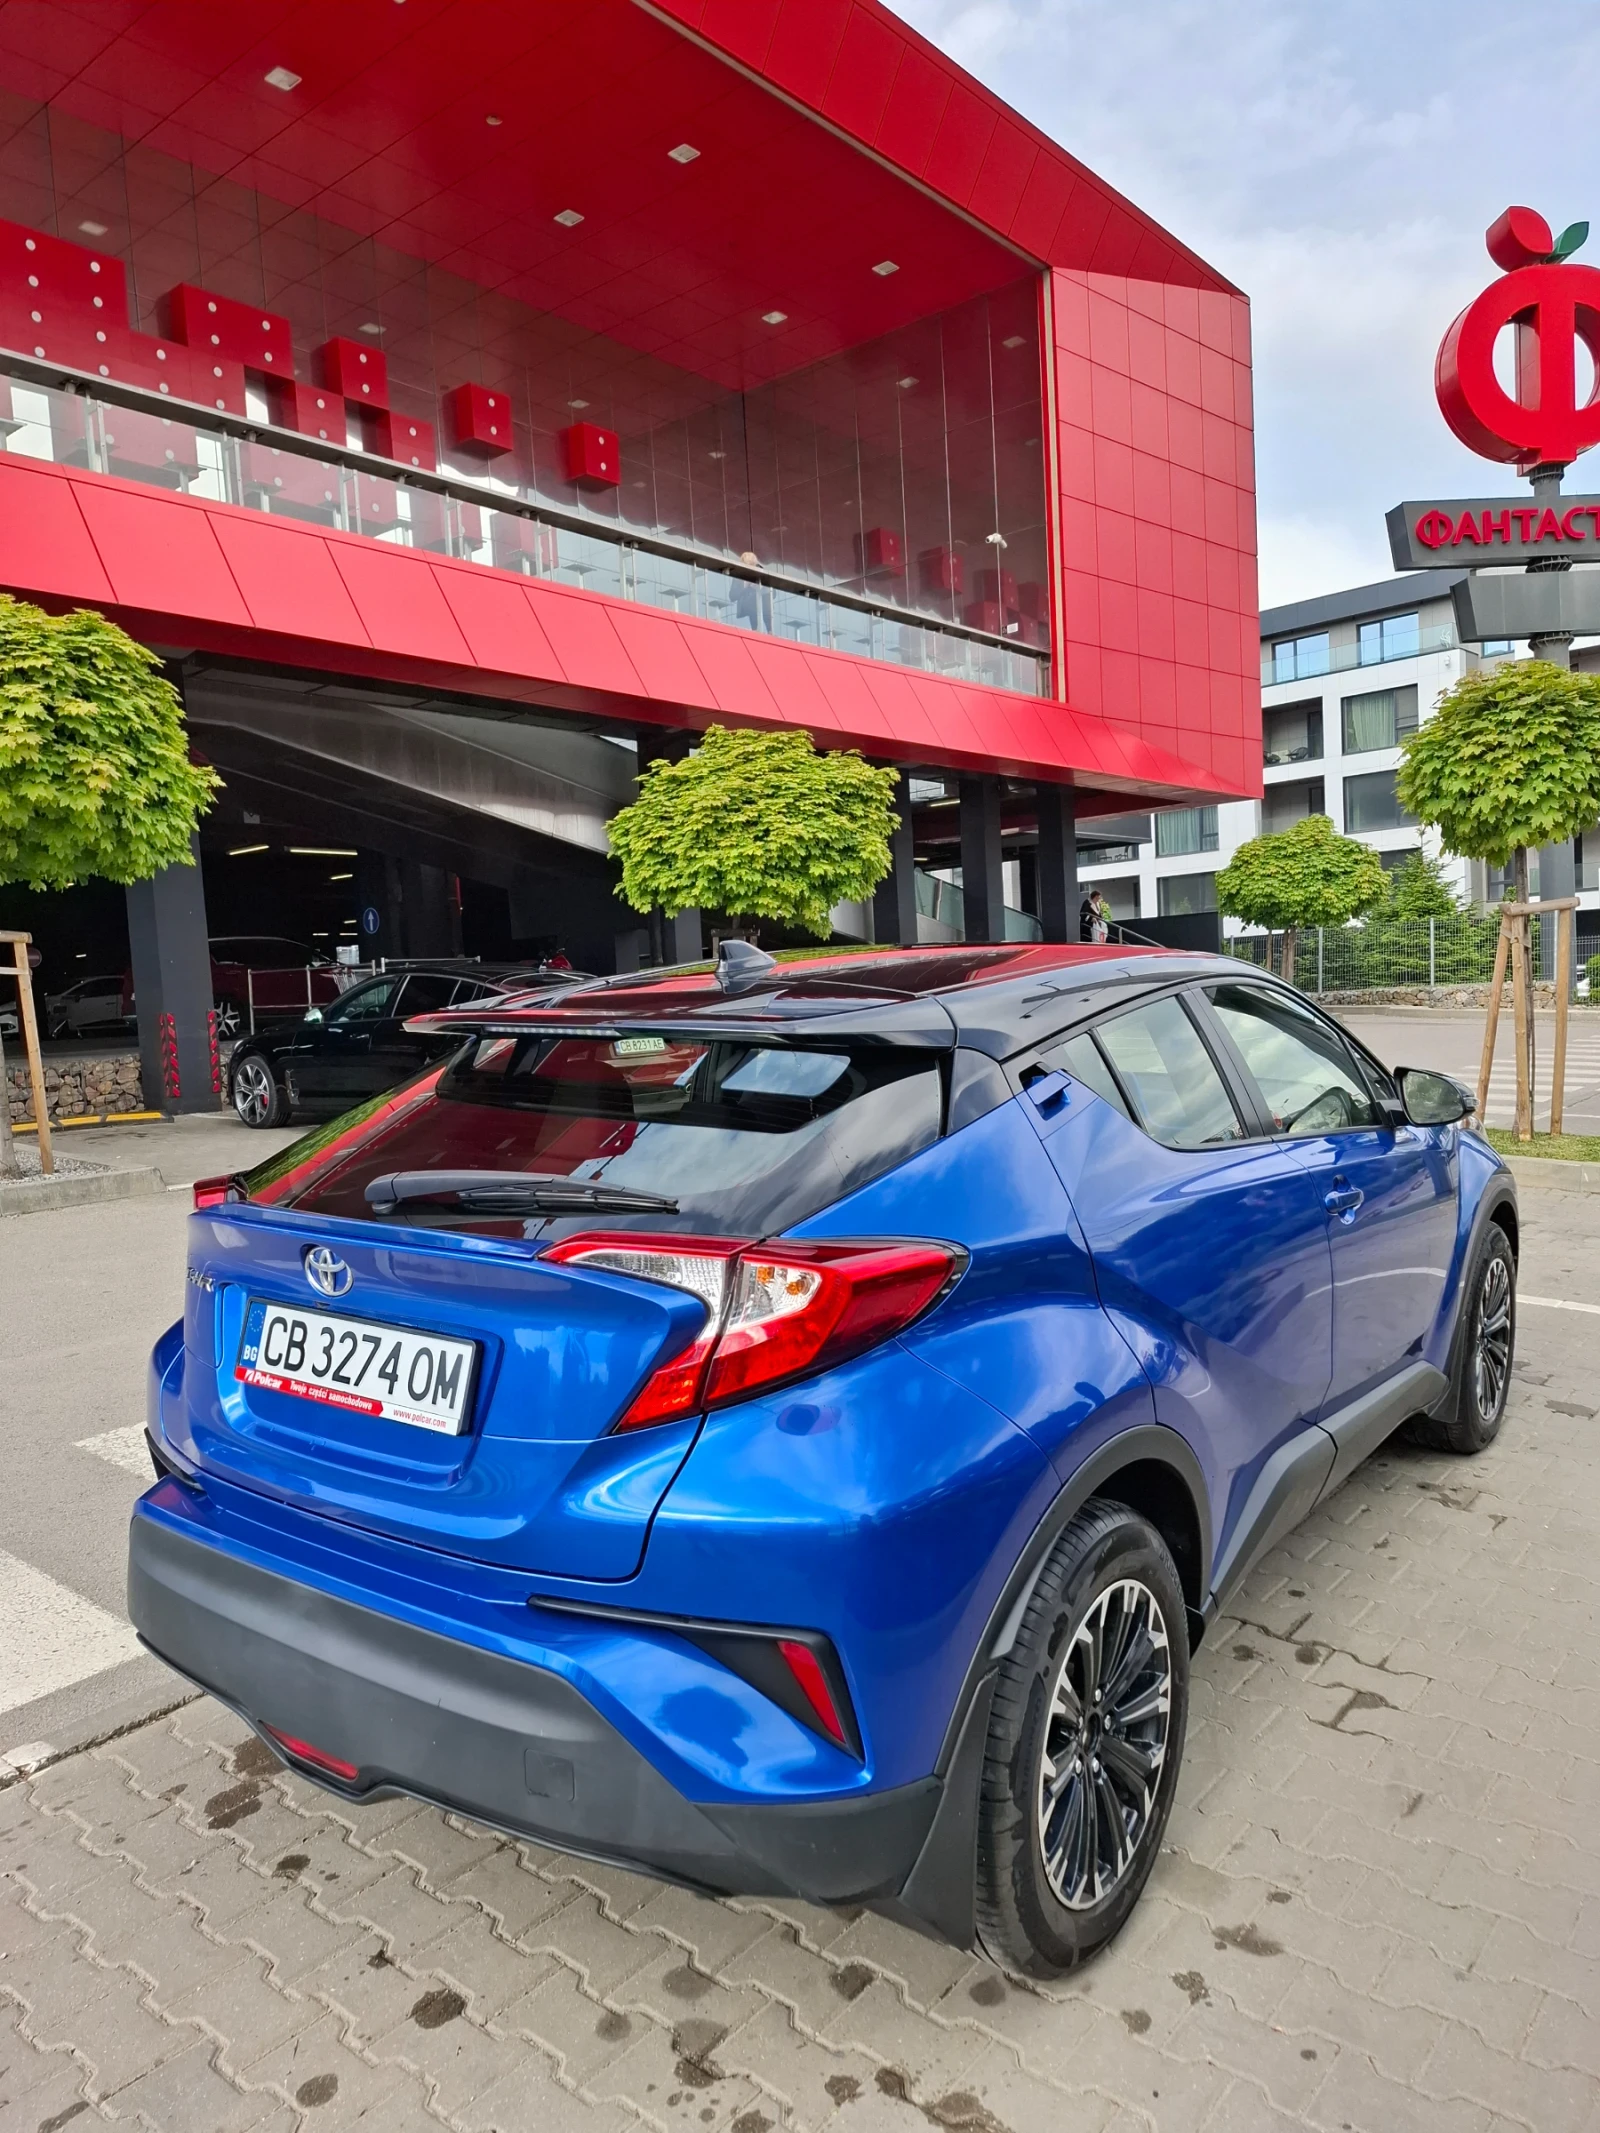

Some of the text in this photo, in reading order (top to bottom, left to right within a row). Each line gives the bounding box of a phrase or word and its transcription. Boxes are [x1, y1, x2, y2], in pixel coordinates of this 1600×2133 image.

[243, 1344, 258, 1361] BG
[264, 1316, 464, 1409] CB 3274 OM
[253, 1372, 373, 1411] Polcar Twoje części samochodowe
[393, 1409, 447, 1428] www.polcar.com
